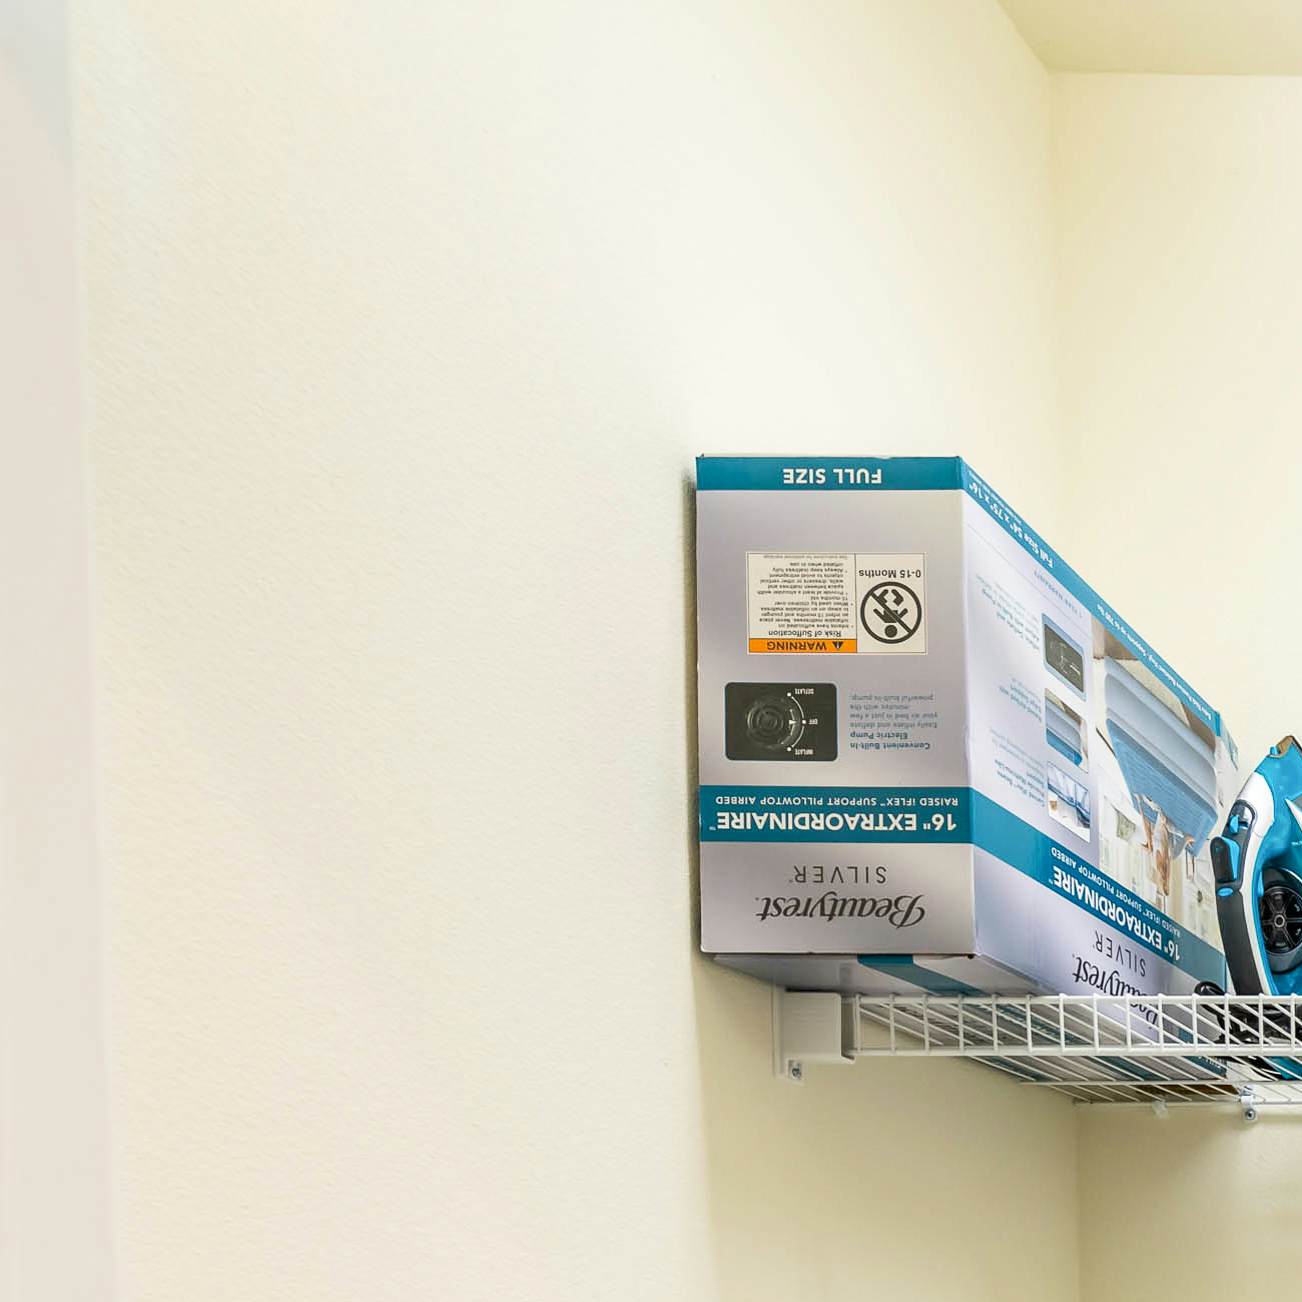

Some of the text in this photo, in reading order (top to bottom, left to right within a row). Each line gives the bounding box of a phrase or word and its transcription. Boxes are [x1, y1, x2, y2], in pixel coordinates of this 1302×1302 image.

[783, 469, 881, 483] FULL SIZE
[1023, 530, 1039, 556] Size
[1040, 547, 1052, 569] Full
[859, 570, 921, 578] 0-15 Months
[767, 641, 827, 650] WARNING
[850, 731, 874, 739] Pump
[716, 796, 755, 805] AIRBED
[760, 796, 823, 805] PILLOWTOP
[828, 797, 876, 806] SUPPORT
[920, 798, 958, 806] RAISED
[922, 813, 957, 831] 16"
[1051, 847, 1076, 868] AIRBED
[793, 866, 887, 884] SILVER
[1078, 866, 1114, 896] PILLOWTOP
[1115, 889, 1141, 913] SUPPORT
[757, 892, 925, 929] Beautyrest
[1095, 931, 1145, 977] SILVER
[1164, 940, 1180, 961] 16"
